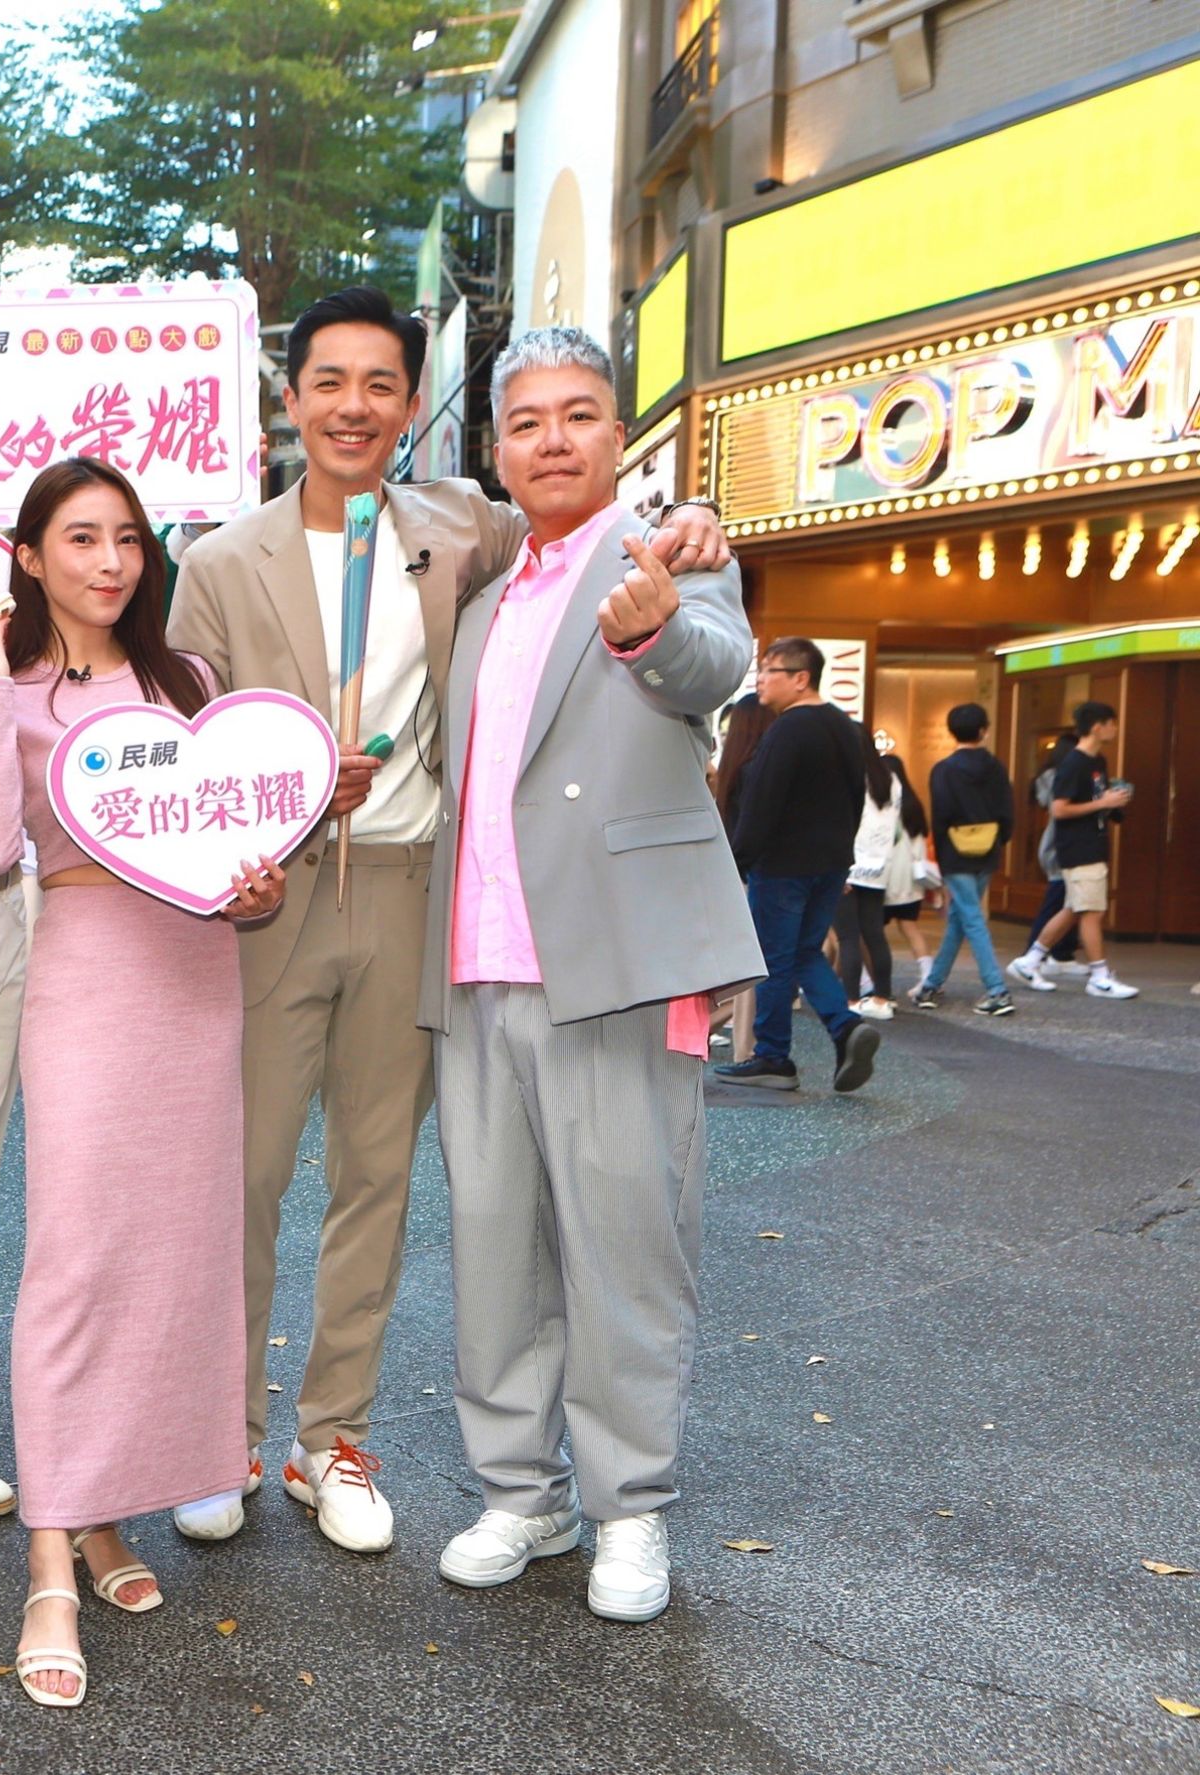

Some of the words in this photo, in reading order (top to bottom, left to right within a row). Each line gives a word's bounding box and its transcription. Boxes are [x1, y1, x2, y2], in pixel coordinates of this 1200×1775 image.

[25, 325, 221, 353] 最新八點大戲
[799, 357, 1036, 504] POP
[1067, 315, 1200, 457] M
[117, 740, 179, 771] 民視
[90, 769, 310, 843] 愛的榮耀
